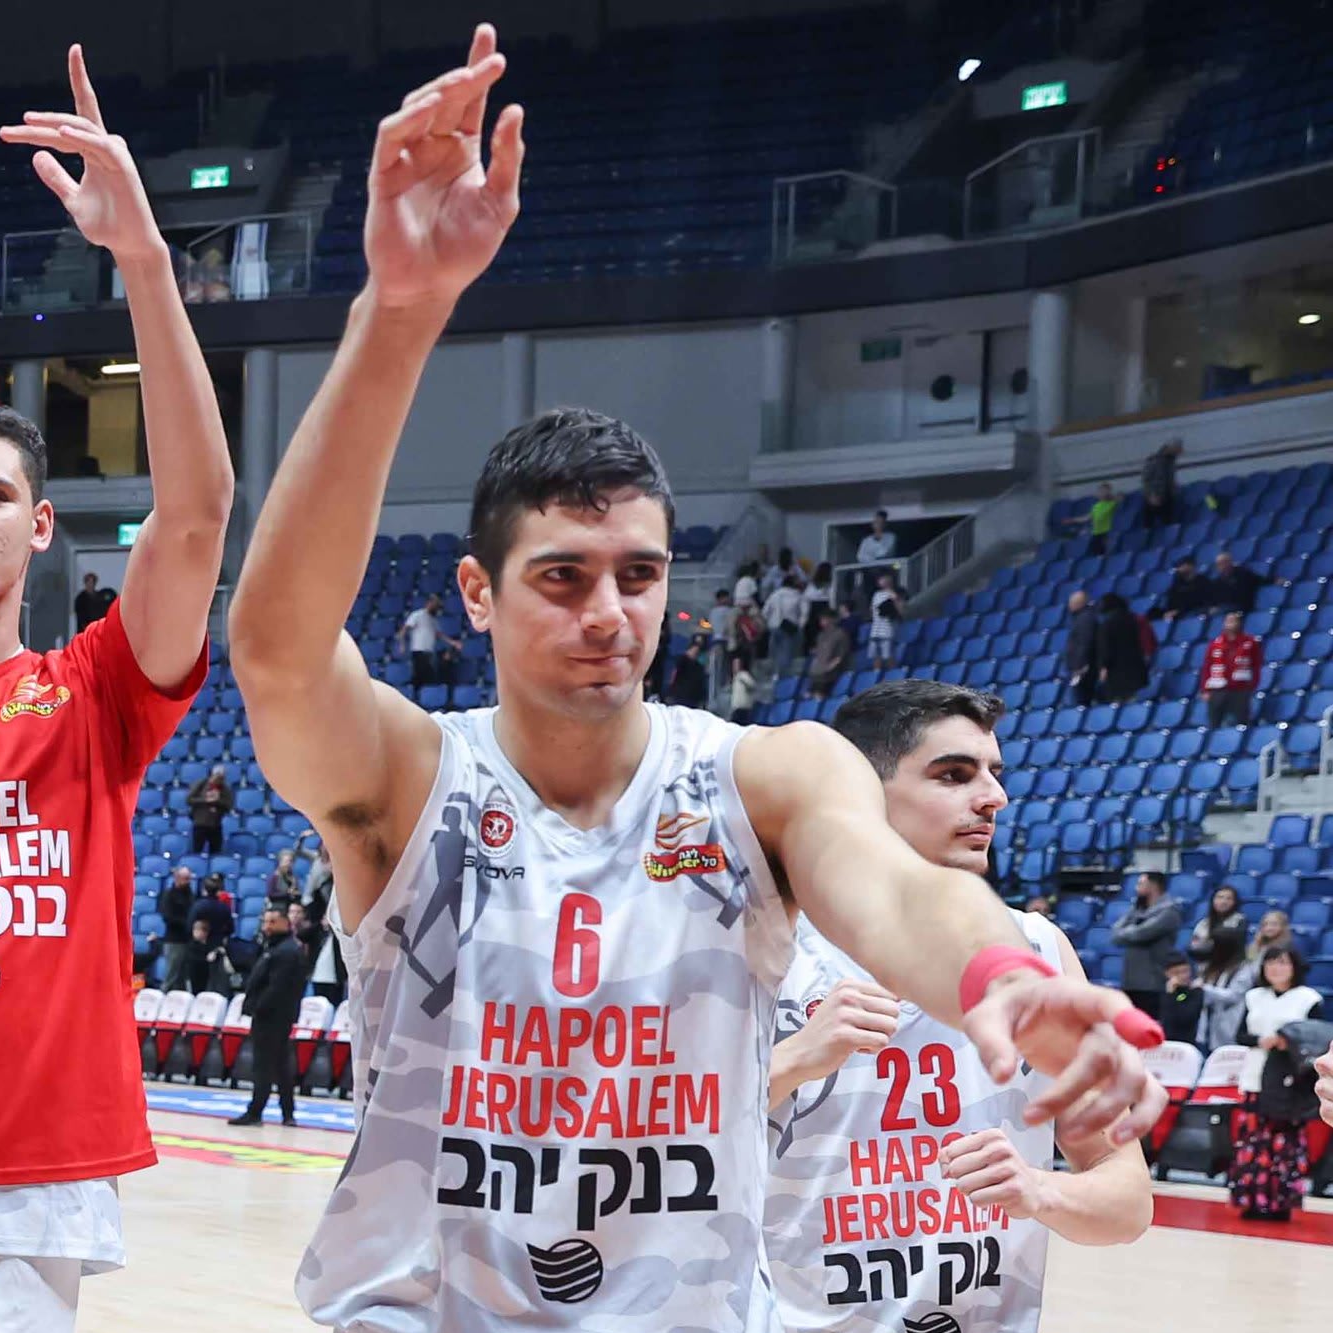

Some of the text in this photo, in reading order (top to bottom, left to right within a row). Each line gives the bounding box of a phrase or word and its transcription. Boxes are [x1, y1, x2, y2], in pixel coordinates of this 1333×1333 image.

[552, 892, 603, 998] 6
[480, 1001, 677, 1067] HAPOEL
[442, 1064, 720, 1140] JERUSALEM
[875, 1042, 963, 1132] 23
[436, 1137, 561, 1215] יהב
[576, 1144, 719, 1232] בנק
[824, 1244, 924, 1306] יהב
